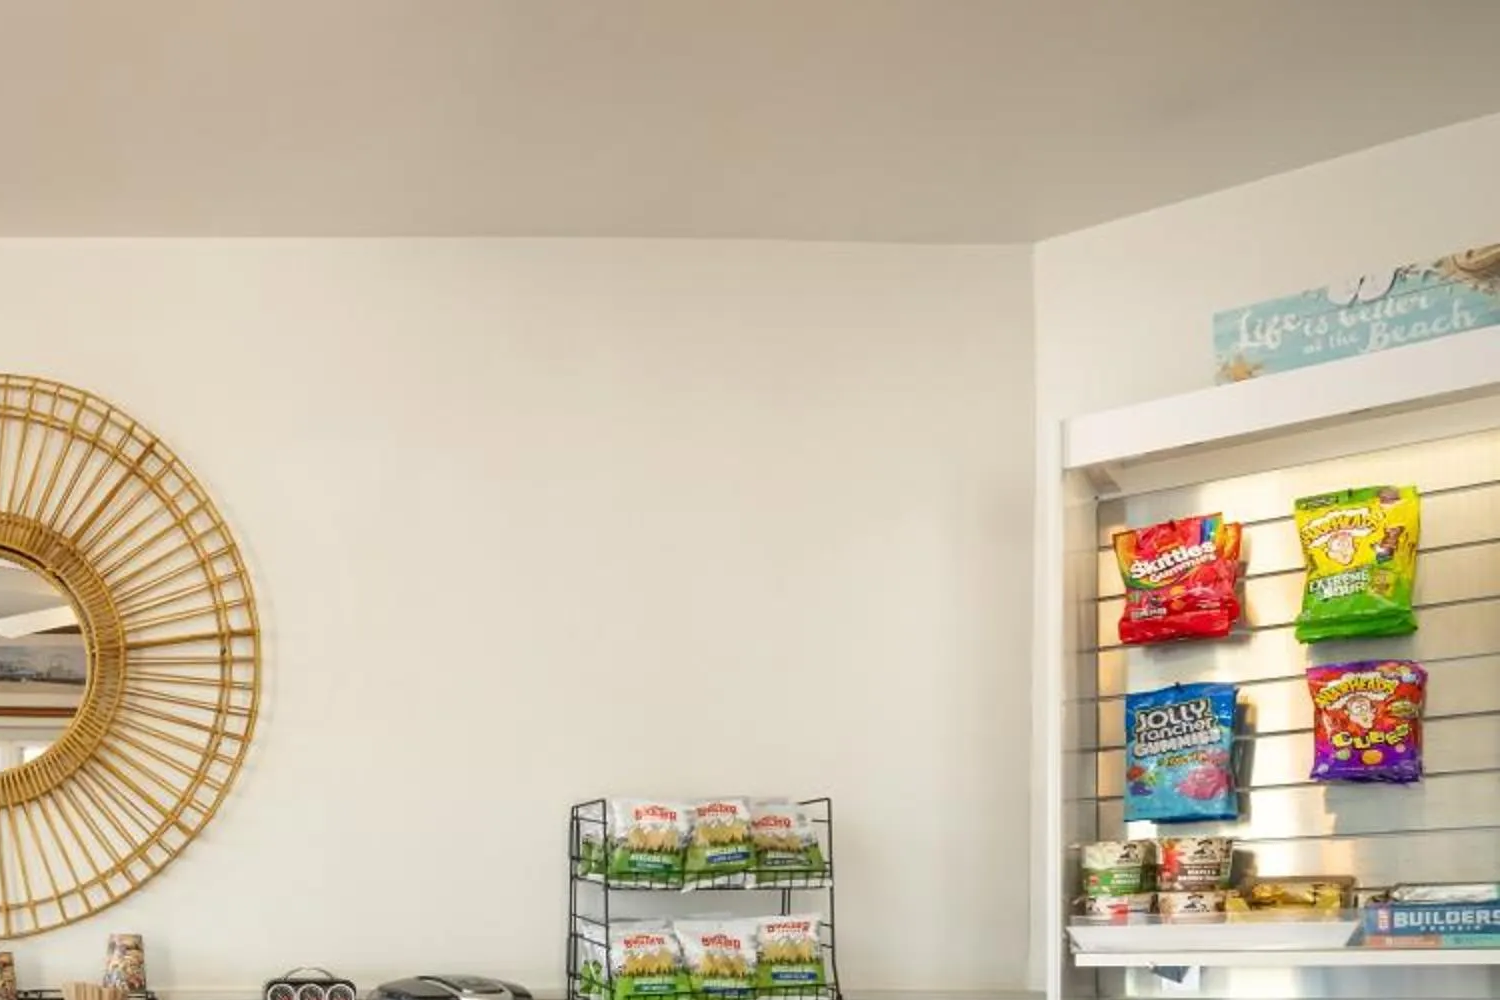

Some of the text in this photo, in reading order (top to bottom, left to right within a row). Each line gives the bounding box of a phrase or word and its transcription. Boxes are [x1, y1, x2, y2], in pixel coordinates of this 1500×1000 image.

[1233, 310, 1300, 350] Life
[1303, 315, 1329, 337] is
[1328, 331, 1360, 349] the
[1361, 299, 1479, 354] Beach
[1131, 541, 1216, 579] Skittles
[1137, 700, 1207, 732] JOLLY
[1141, 718, 1213, 743] rancher
